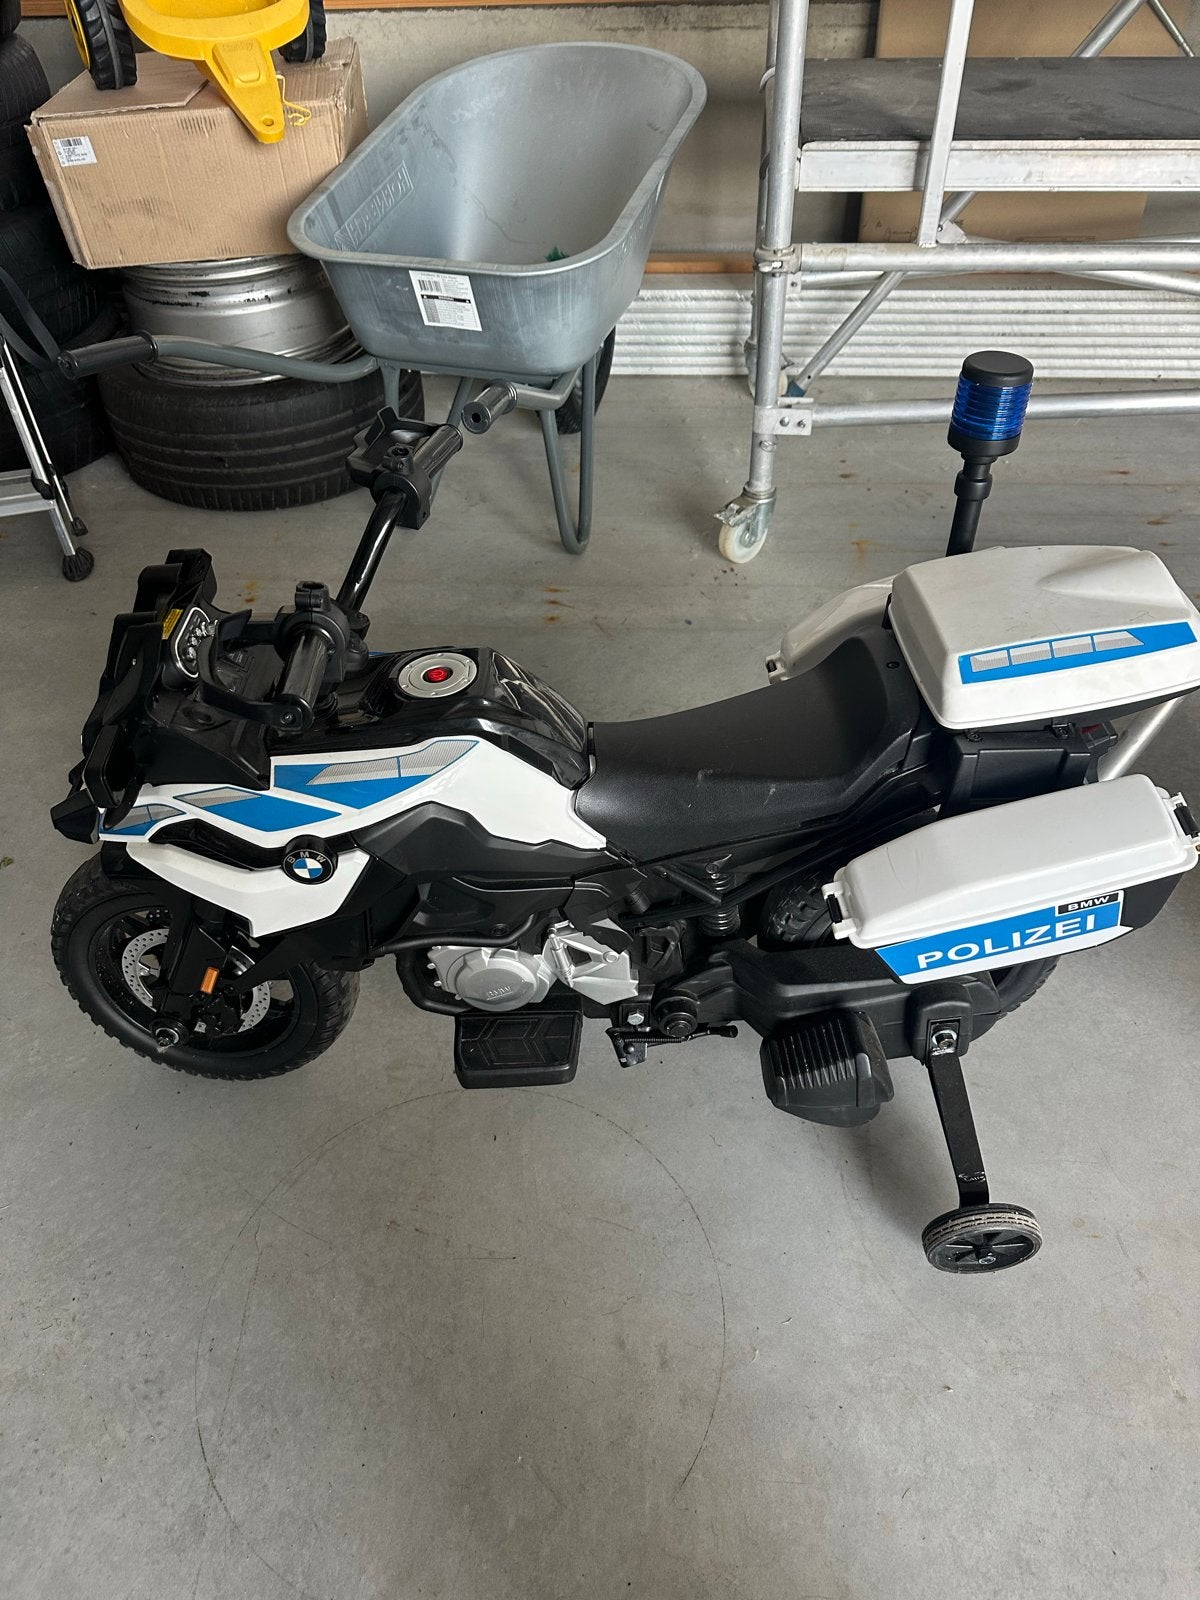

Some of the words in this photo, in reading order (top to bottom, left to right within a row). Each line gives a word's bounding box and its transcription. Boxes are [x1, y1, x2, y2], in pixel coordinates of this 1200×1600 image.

[286, 851, 327, 864] BMW
[1067, 895, 1110, 911] BMW
[916, 914, 1096, 969] POLIZEI
